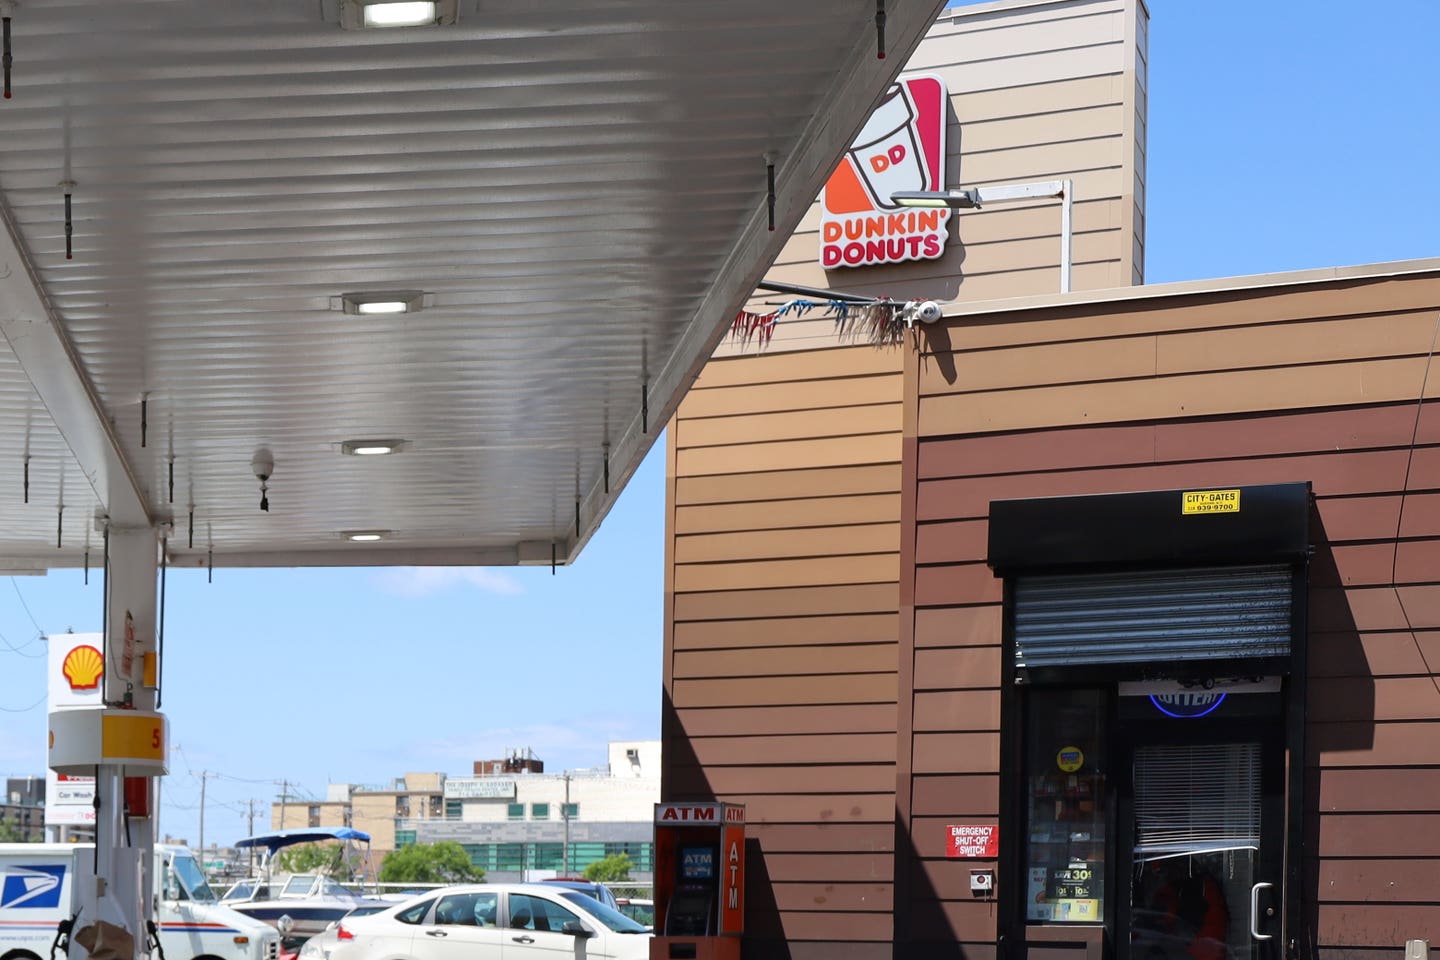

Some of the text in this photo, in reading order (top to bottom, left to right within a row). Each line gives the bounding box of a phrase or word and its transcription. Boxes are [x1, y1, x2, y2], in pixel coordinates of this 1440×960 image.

[869, 144, 906, 174] DD
[823, 209, 947, 243] DUNKIN'
[823, 234, 940, 266] DONUTS
[152, 728, 160, 749] 5
[663, 807, 714, 821] ATM
[726, 808, 744, 821] ATM
[951, 827, 993, 836] EMERGENCY
[955, 836, 989, 845] SHUT-OFF
[960, 846, 986, 855] SWITCH
[684, 854, 712, 864] ATM
[728, 841, 739, 909] ATM
